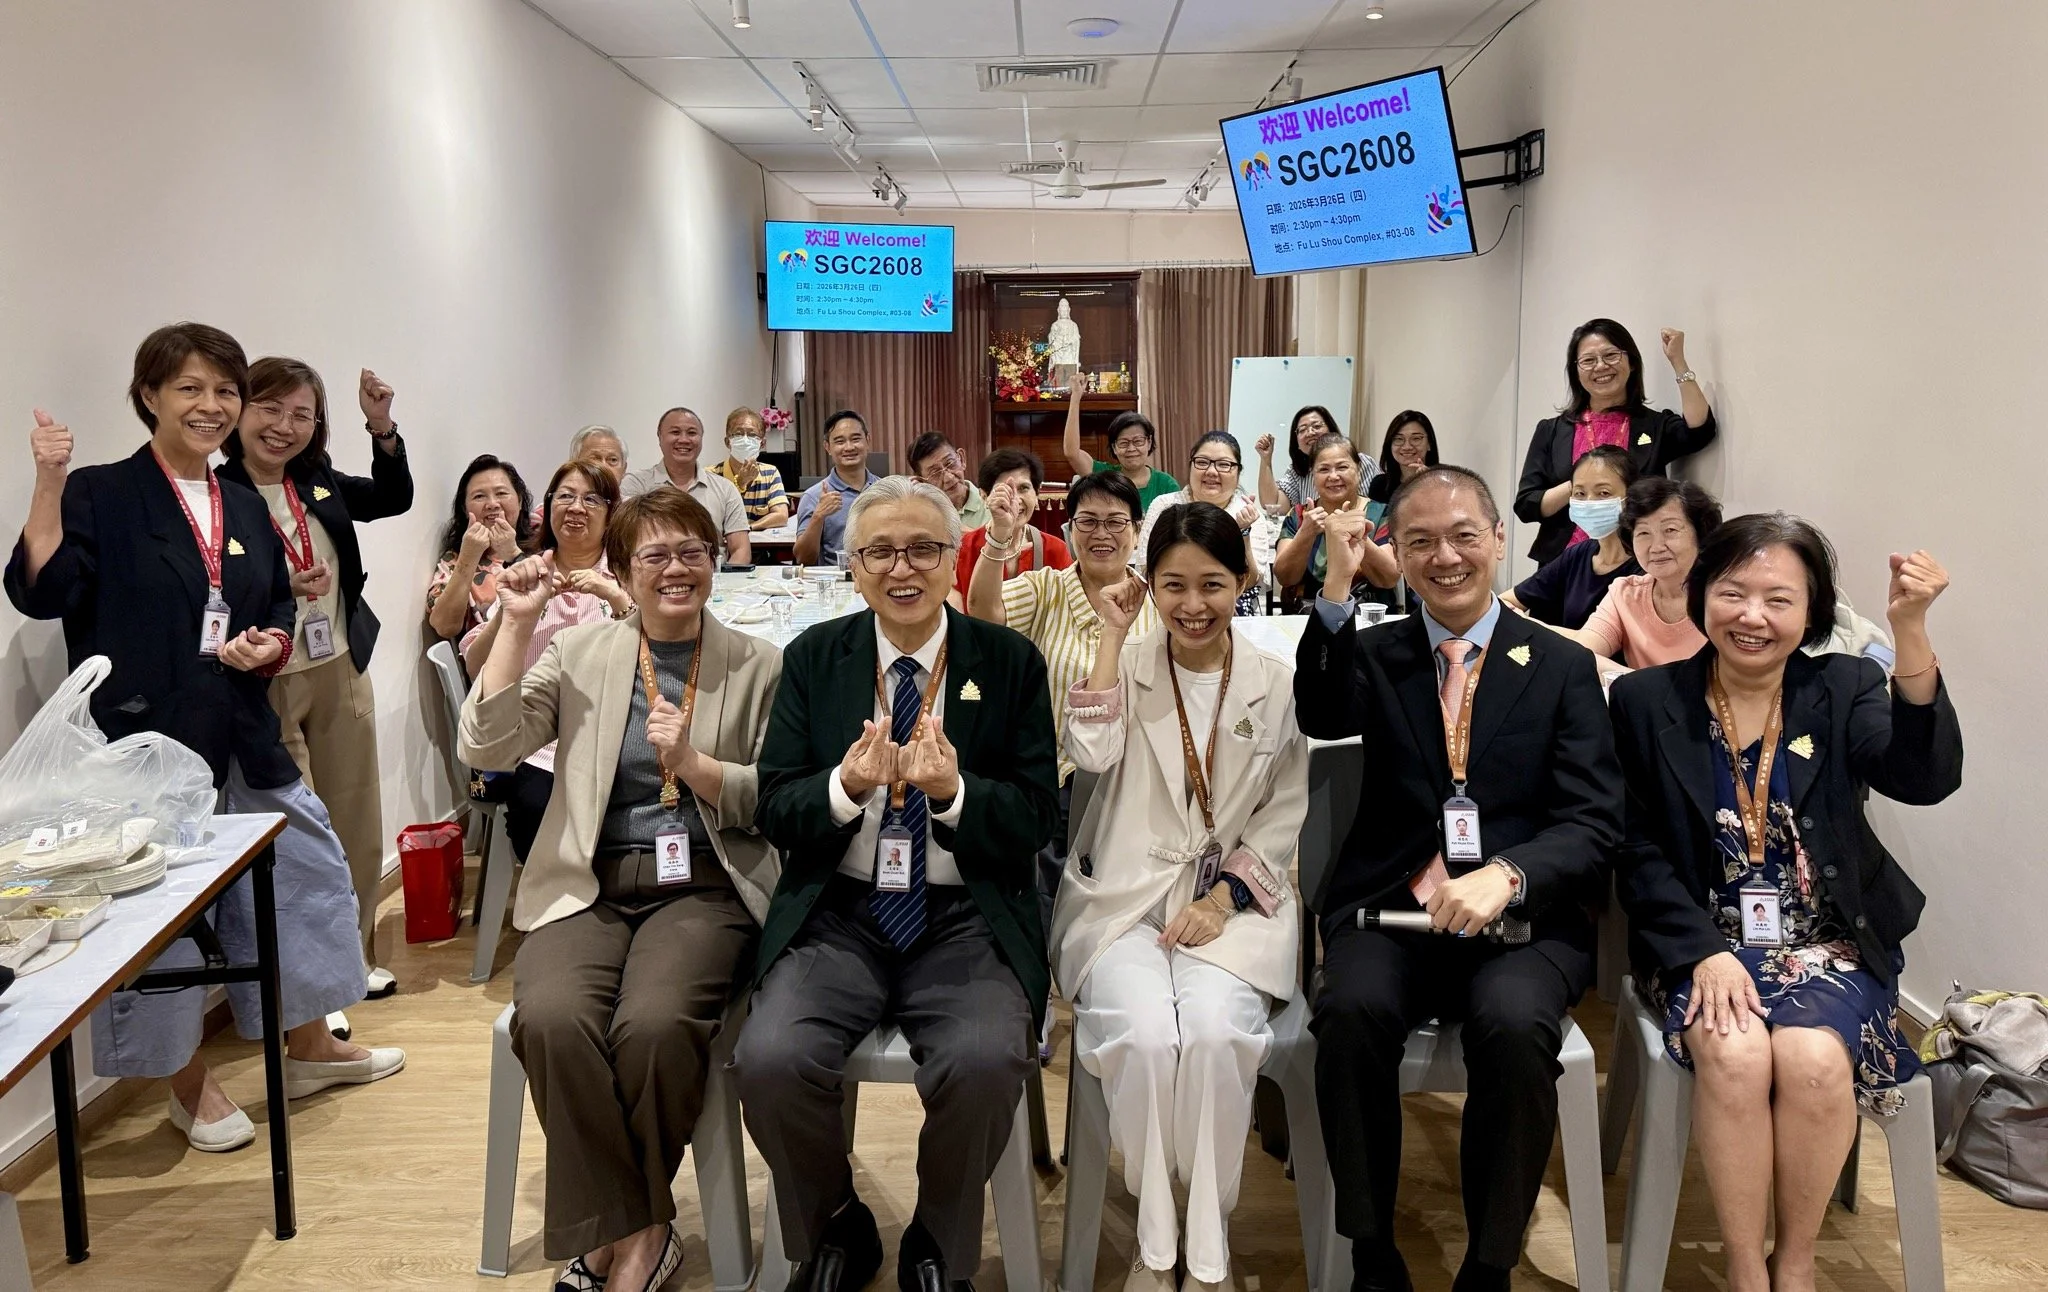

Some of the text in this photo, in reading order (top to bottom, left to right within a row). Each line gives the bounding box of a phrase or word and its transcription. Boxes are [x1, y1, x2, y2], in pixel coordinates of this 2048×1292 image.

[1258, 86, 1411, 145] 欢迎 Welcome!
[1278, 132, 1415, 186] SGC2608
[1293, 220, 1322, 231] 2:30pm
[1331, 215, 1361, 225] 4:30pm
[805, 230, 926, 248] 欢迎 Welcome!
[1297, 240, 1308, 250] Fu
[1309, 240, 1320, 249] Lu
[1321, 238, 1343, 247] Shou
[1344, 232, 1385, 244] Complex,
[1386, 227, 1415, 239] #03-08
[815, 254, 923, 276] SGC2608
[850, 296, 874, 304] 4:30pm
